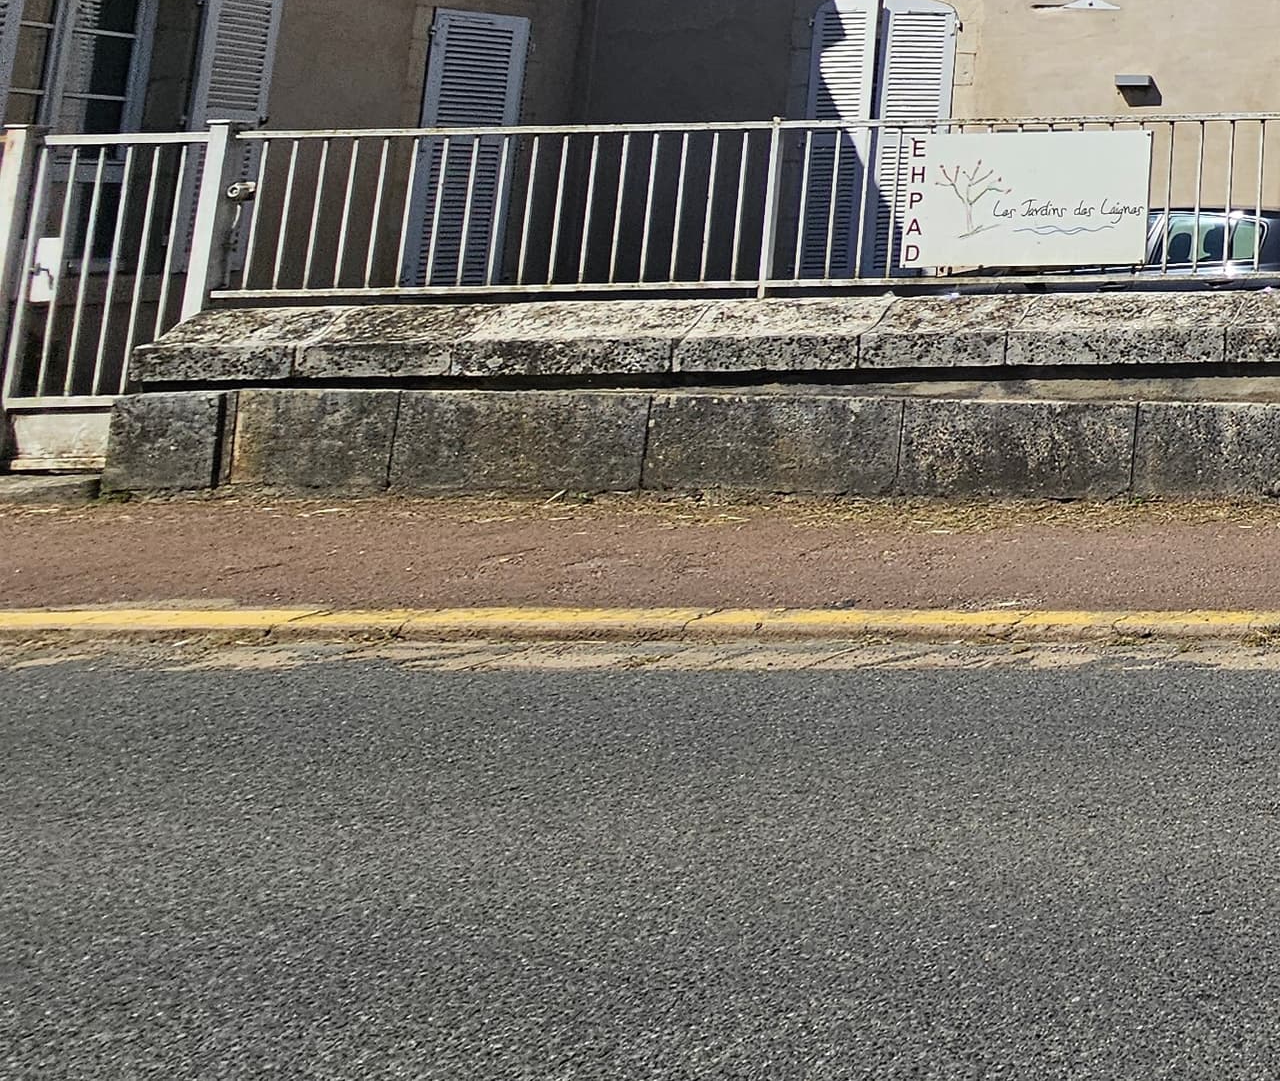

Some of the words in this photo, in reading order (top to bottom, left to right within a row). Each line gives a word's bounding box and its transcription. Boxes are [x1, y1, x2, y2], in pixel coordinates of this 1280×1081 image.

[905, 139, 926, 262] EHPAD
[993, 200, 1016, 218] Les
[1021, 199, 1067, 218] Jardins
[1073, 200, 1095, 217] des
